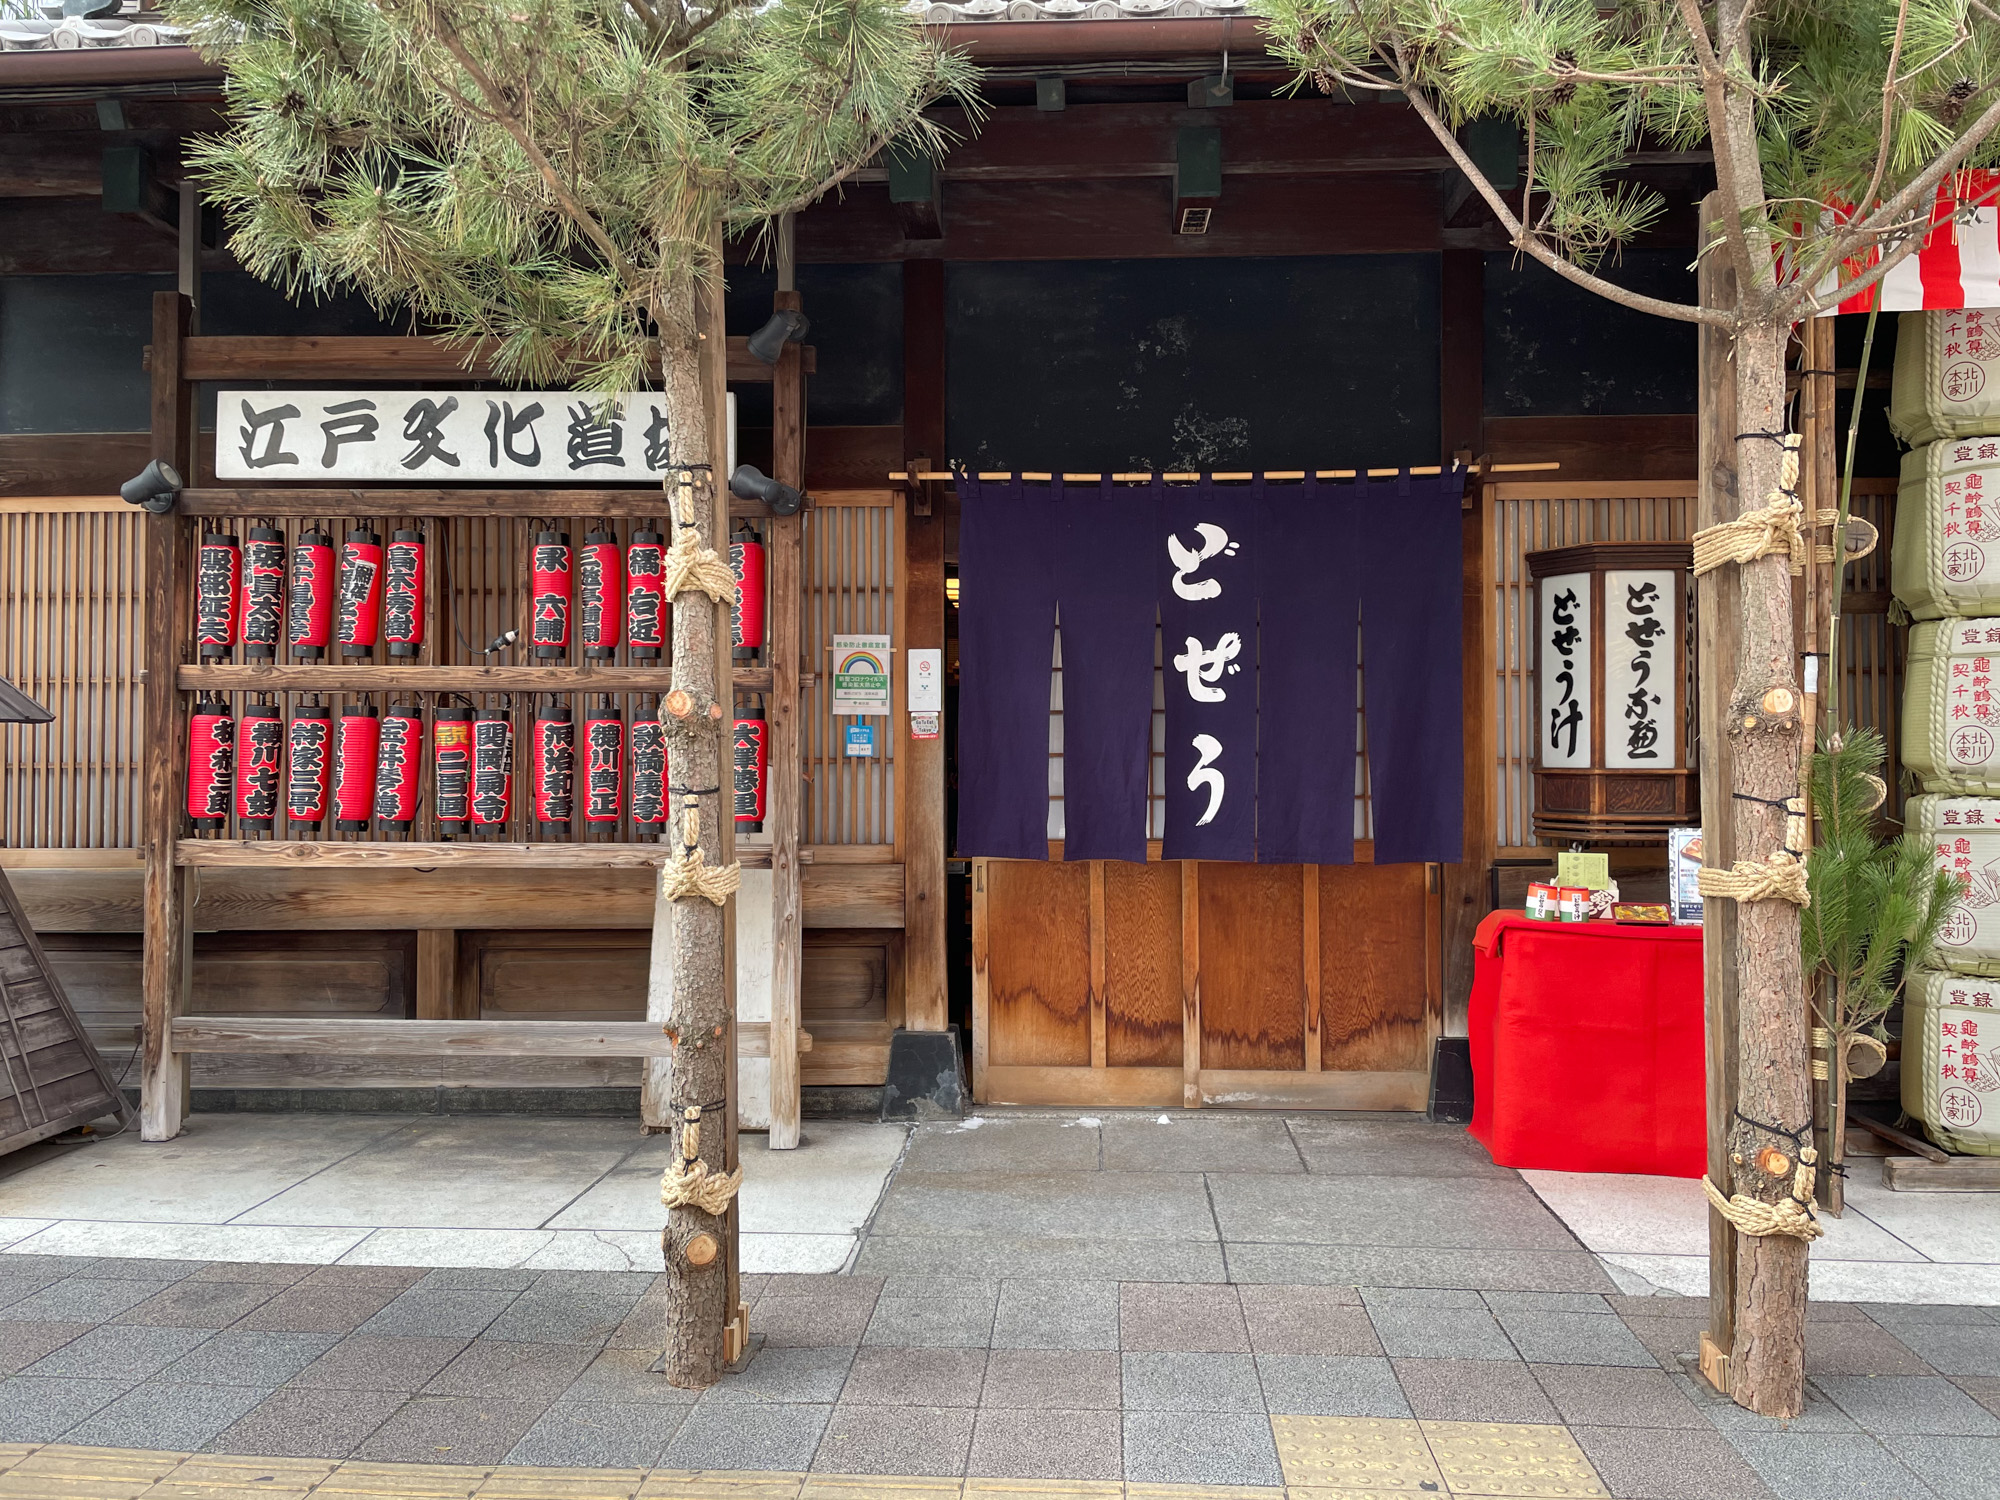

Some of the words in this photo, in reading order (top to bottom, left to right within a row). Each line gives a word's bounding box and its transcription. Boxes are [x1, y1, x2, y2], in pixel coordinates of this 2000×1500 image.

[1167, 522, 1242, 827] どぜう
[1551, 588, 1583, 758] どぜう汁
[289, 722, 326, 816] 林家三平
